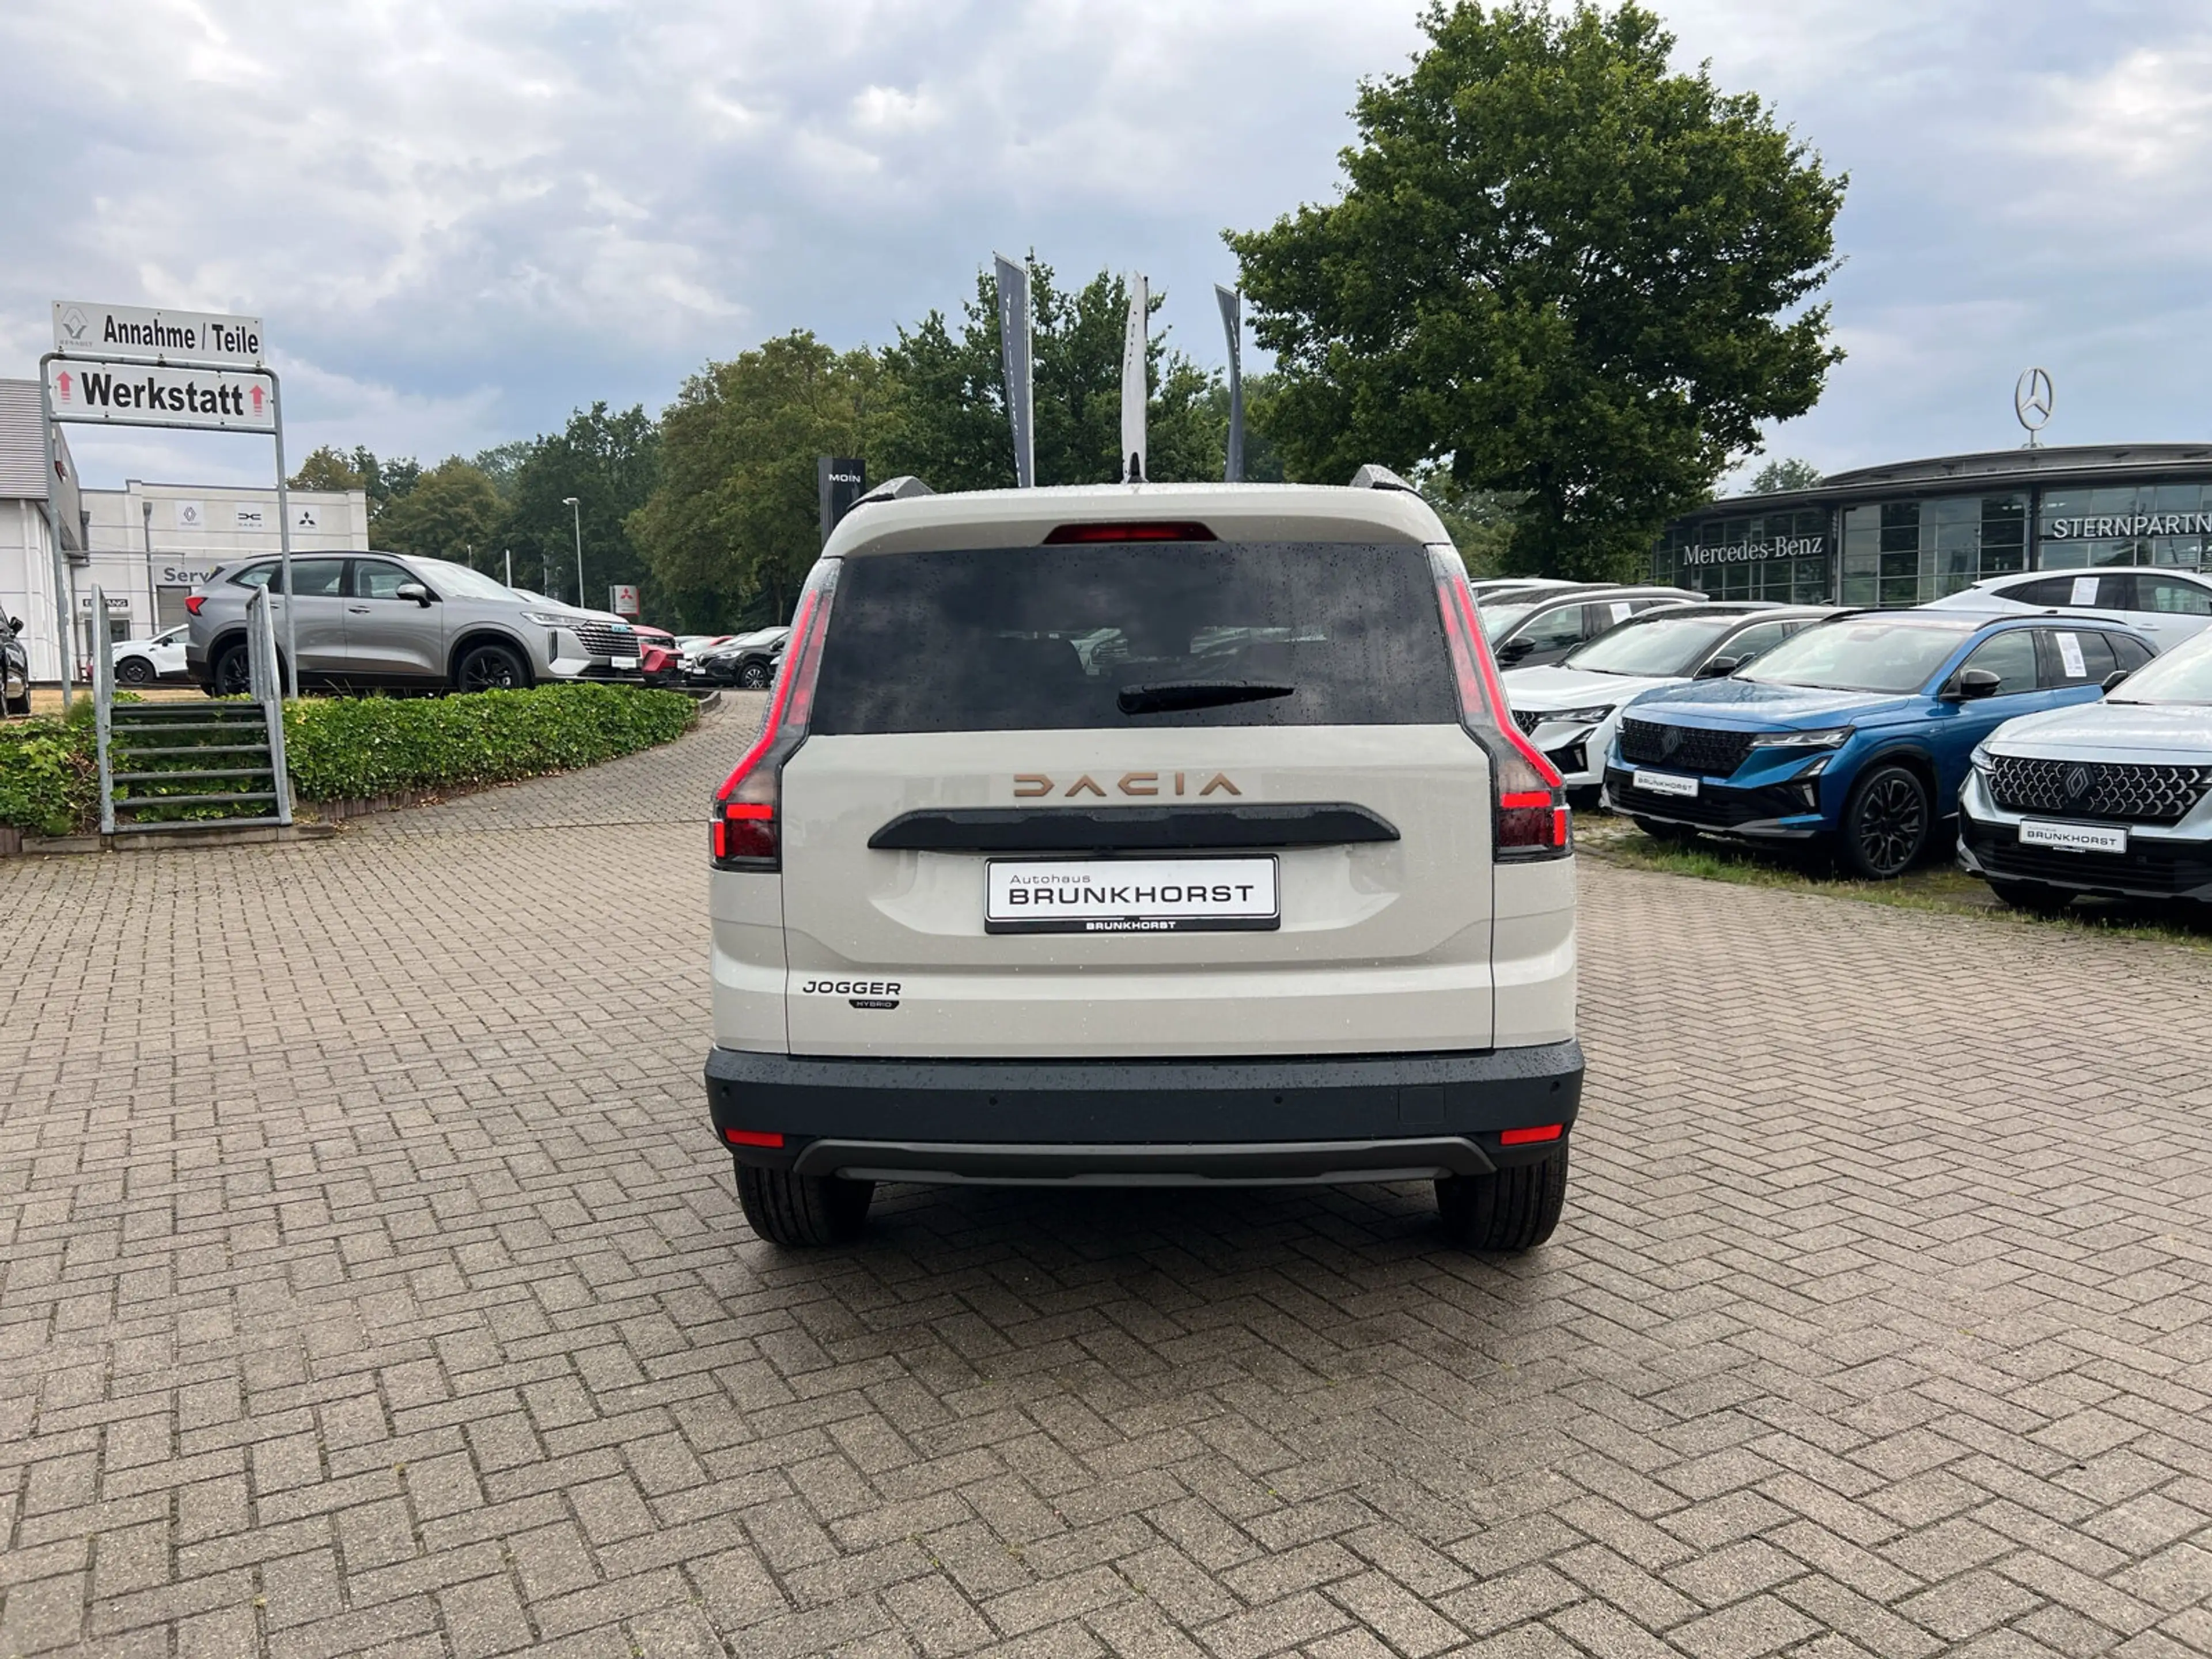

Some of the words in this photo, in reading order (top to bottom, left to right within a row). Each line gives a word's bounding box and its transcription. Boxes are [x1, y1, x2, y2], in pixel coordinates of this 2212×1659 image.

[104, 315, 195, 349] Annahme
[211, 324, 259, 354] Teile
[81, 372, 244, 416] Werkstatt
[828, 474, 861, 483] MOIN
[2053, 514, 2212, 539] STERNPARTN
[1683, 536, 1823, 566] Mercedes-Benz
[164, 567, 215, 582] Serv
[1013, 772, 1242, 797] DACIA
[2027, 830, 2117, 846] BRUNKHORST
[1010, 874, 1091, 884] Autohaus
[1009, 885, 1255, 905] BRUNKHORST
[1086, 922, 1176, 930] BRUNKHORST
[802, 981, 902, 995] JOGGER
